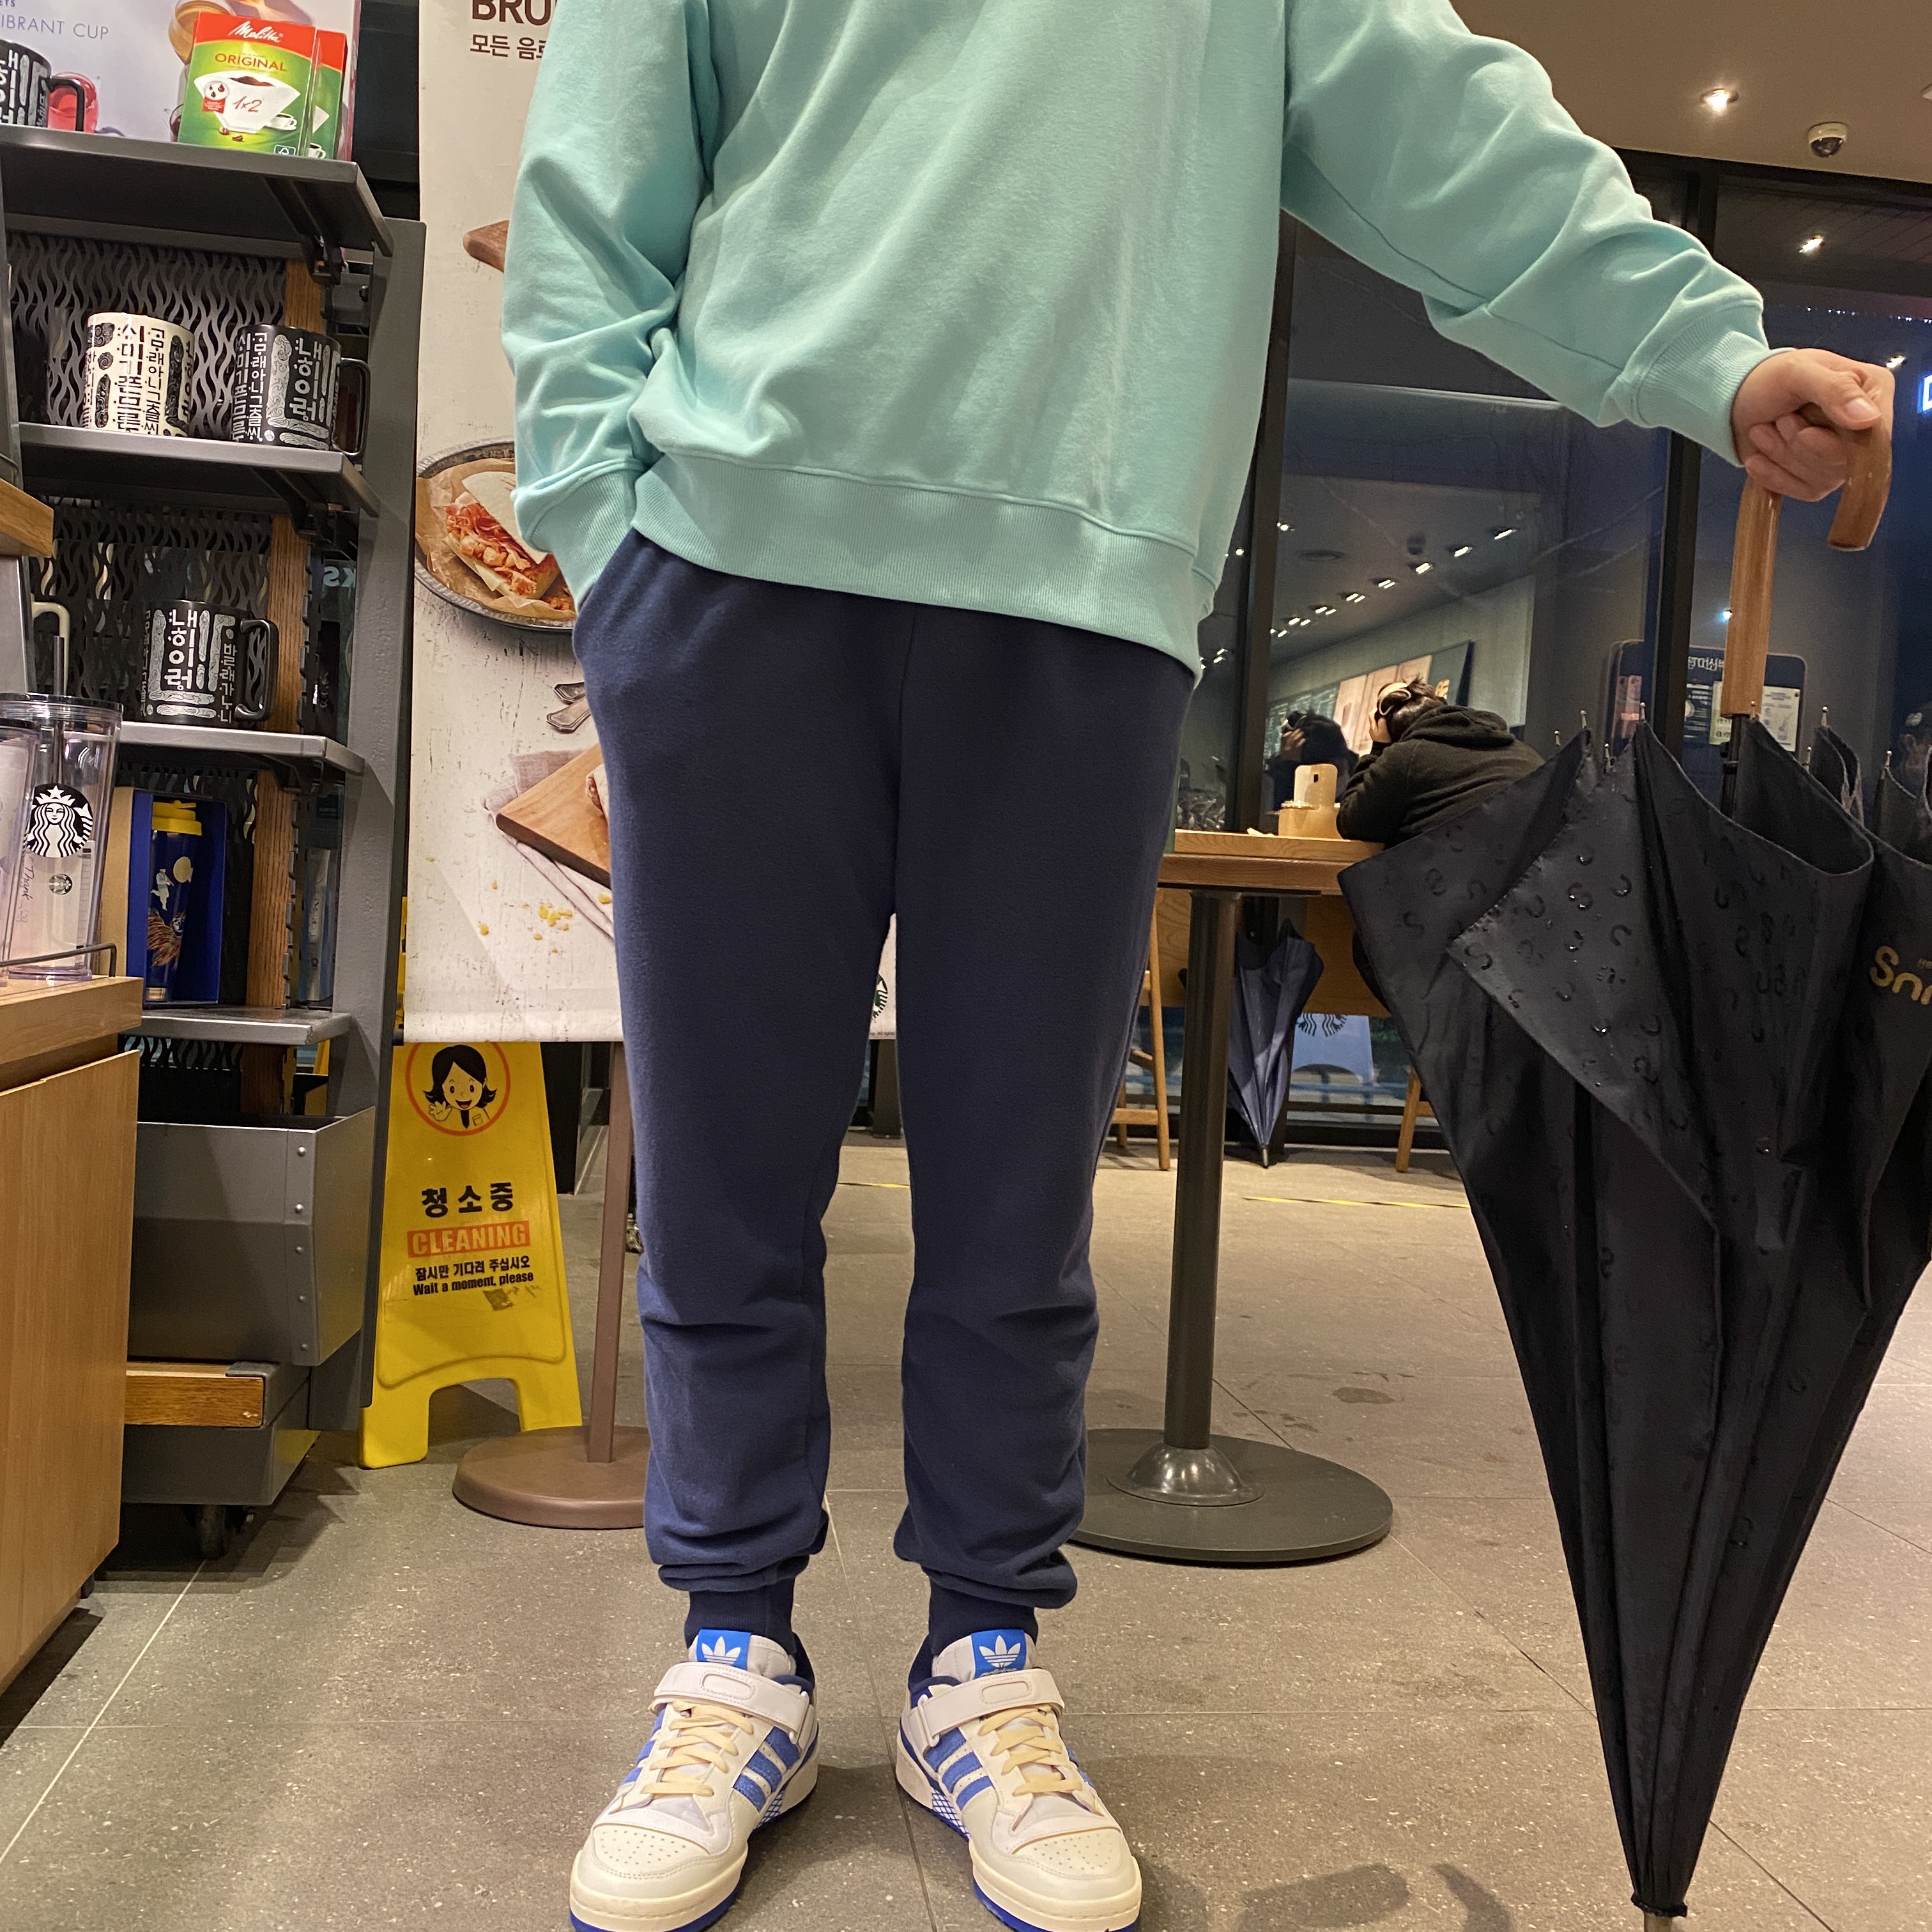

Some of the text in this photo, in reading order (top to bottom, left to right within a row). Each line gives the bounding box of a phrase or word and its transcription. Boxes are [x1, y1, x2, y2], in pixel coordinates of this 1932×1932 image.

[471, 0, 556, 26] BRU
[0, 14, 109, 40] IBRANT CUP
[227, 21, 280, 43] Melitta
[470, 34, 510, 57] 모든
[215, 53, 287, 72] ORIGINAL
[233, 95, 263, 112] 1x2
[412, 1223, 526, 1255] CLEANING
[415, 1255, 530, 1282] 잠시만 기다려 주십시오
[413, 1282, 439, 1296] Wait
[441, 1282, 448, 1292] a
[499, 1271, 533, 1286] please
